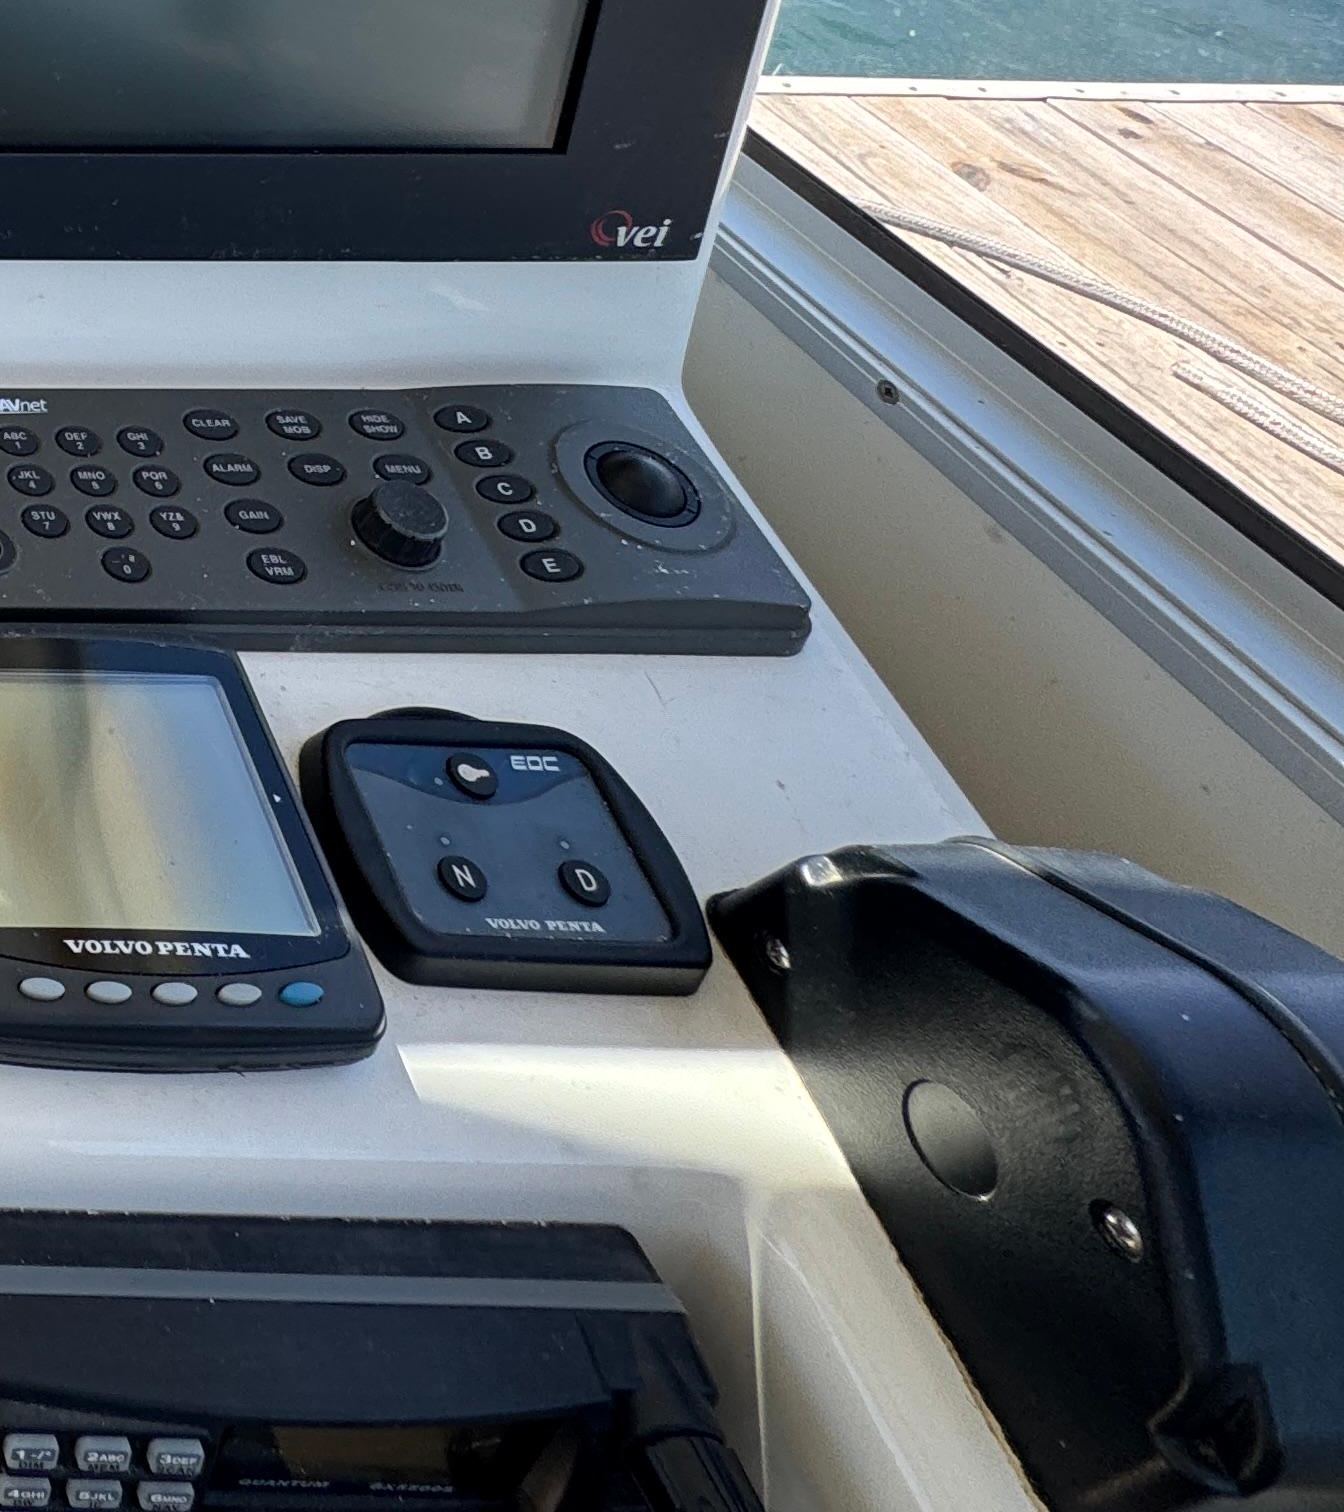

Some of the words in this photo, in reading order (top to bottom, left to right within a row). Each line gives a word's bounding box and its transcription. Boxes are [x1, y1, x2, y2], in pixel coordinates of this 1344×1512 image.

[617, 219, 672, 247] vei
[192, 419, 230, 427] CLEAR
[277, 415, 305, 424] SAVE
[361, 415, 388, 424] HIDE
[455, 412, 470, 424] A
[364, 425, 398, 434] SHOW
[127, 432, 148, 441] GHI
[476, 446, 491, 460] B
[212, 464, 253, 473] ALARM
[386, 464, 421, 475] MENU
[18, 471, 40, 479] JKL
[78, 472, 106, 480] MNO
[498, 482, 512, 495] C
[31, 511, 56, 521] STU
[93, 511, 121, 521] VWX
[239, 511, 270, 520] GAIN
[519, 519, 535, 532] D
[262, 555, 285, 563] EBL
[543, 558, 559, 572] E
[266, 566, 294, 576] VRM
[452, 865, 476, 887] N
[577, 869, 598, 891] D
[486, 918, 540, 931] VOLVO
[544, 920, 605, 933] PENTA
[64, 939, 153, 955] VOLVO
[156, 941, 251, 959] PENTA
[238, 1477, 330, 1488] QUANTUM
